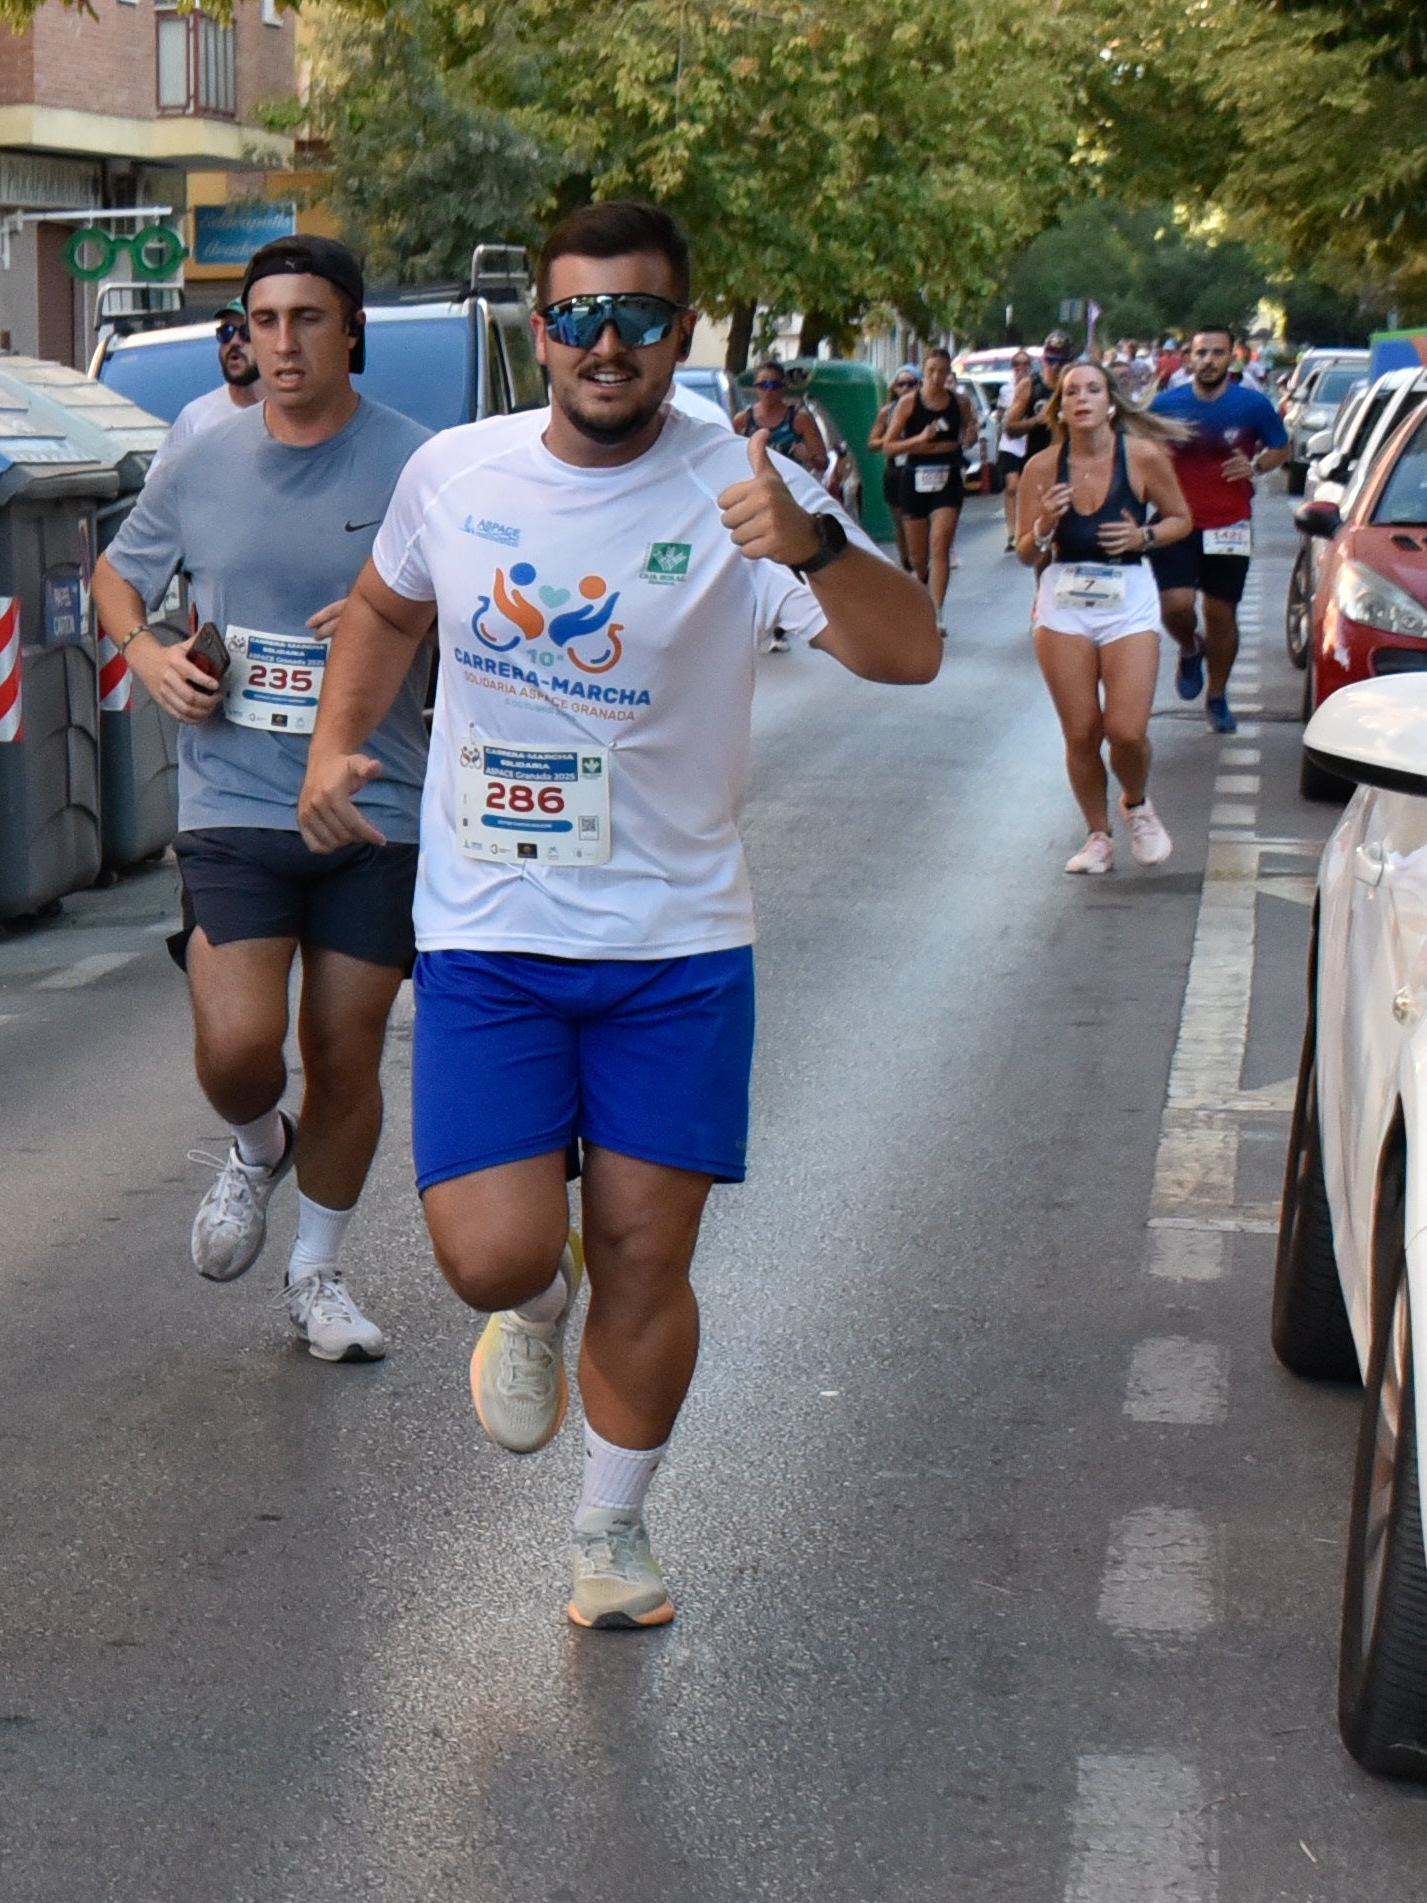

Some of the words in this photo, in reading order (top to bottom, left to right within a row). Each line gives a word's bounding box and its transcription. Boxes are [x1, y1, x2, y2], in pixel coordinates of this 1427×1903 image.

[477, 518, 521, 537] ASPACE
[1083, 579, 1096, 591] 7
[248, 664, 313, 692] 235
[453, 647, 651, 706] CARRERA-MARCHA
[521, 686, 568, 709] ASPACE
[572, 702, 635, 721] GRANADA
[486, 767, 515, 778] ASPACE
[516, 771, 552, 780] Granada
[554, 772, 576, 781] 2025
[500, 759, 551, 770] SOLIDARIA
[486, 781, 565, 814] 286
